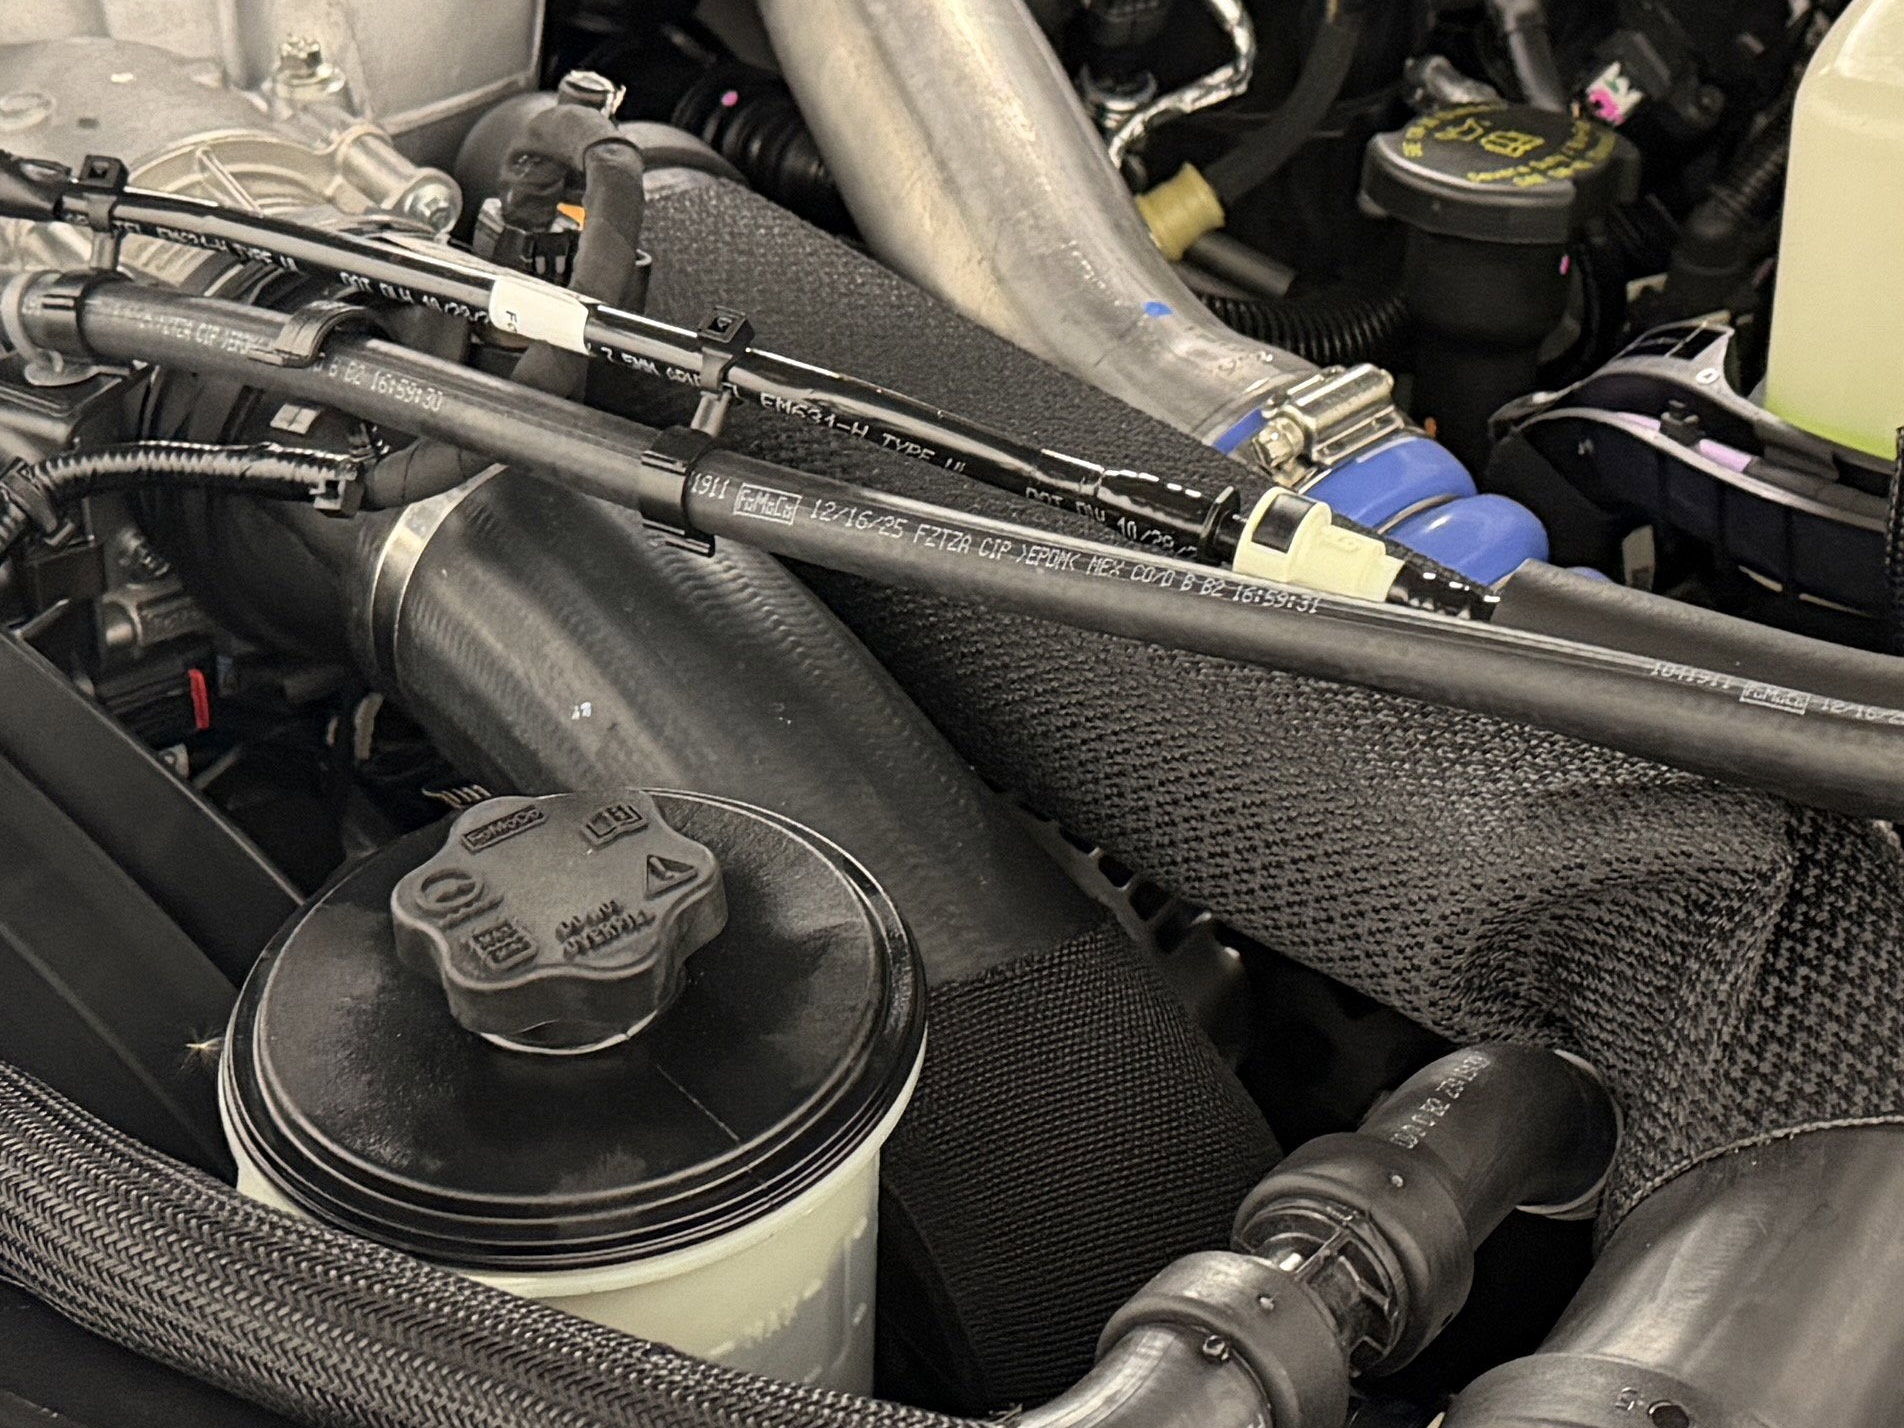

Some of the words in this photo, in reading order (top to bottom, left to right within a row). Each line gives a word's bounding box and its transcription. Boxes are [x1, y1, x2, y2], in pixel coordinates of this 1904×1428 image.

[881, 432, 935, 466] TYPE
[809, 498, 904, 540] 12/16/25
[978, 534, 1013, 562] CIP
[1086, 550, 1125, 578] MEX
[1180, 573, 1195, 594] B
[1200, 577, 1225, 599] B2
[1231, 582, 1324, 615] 16:59:31
